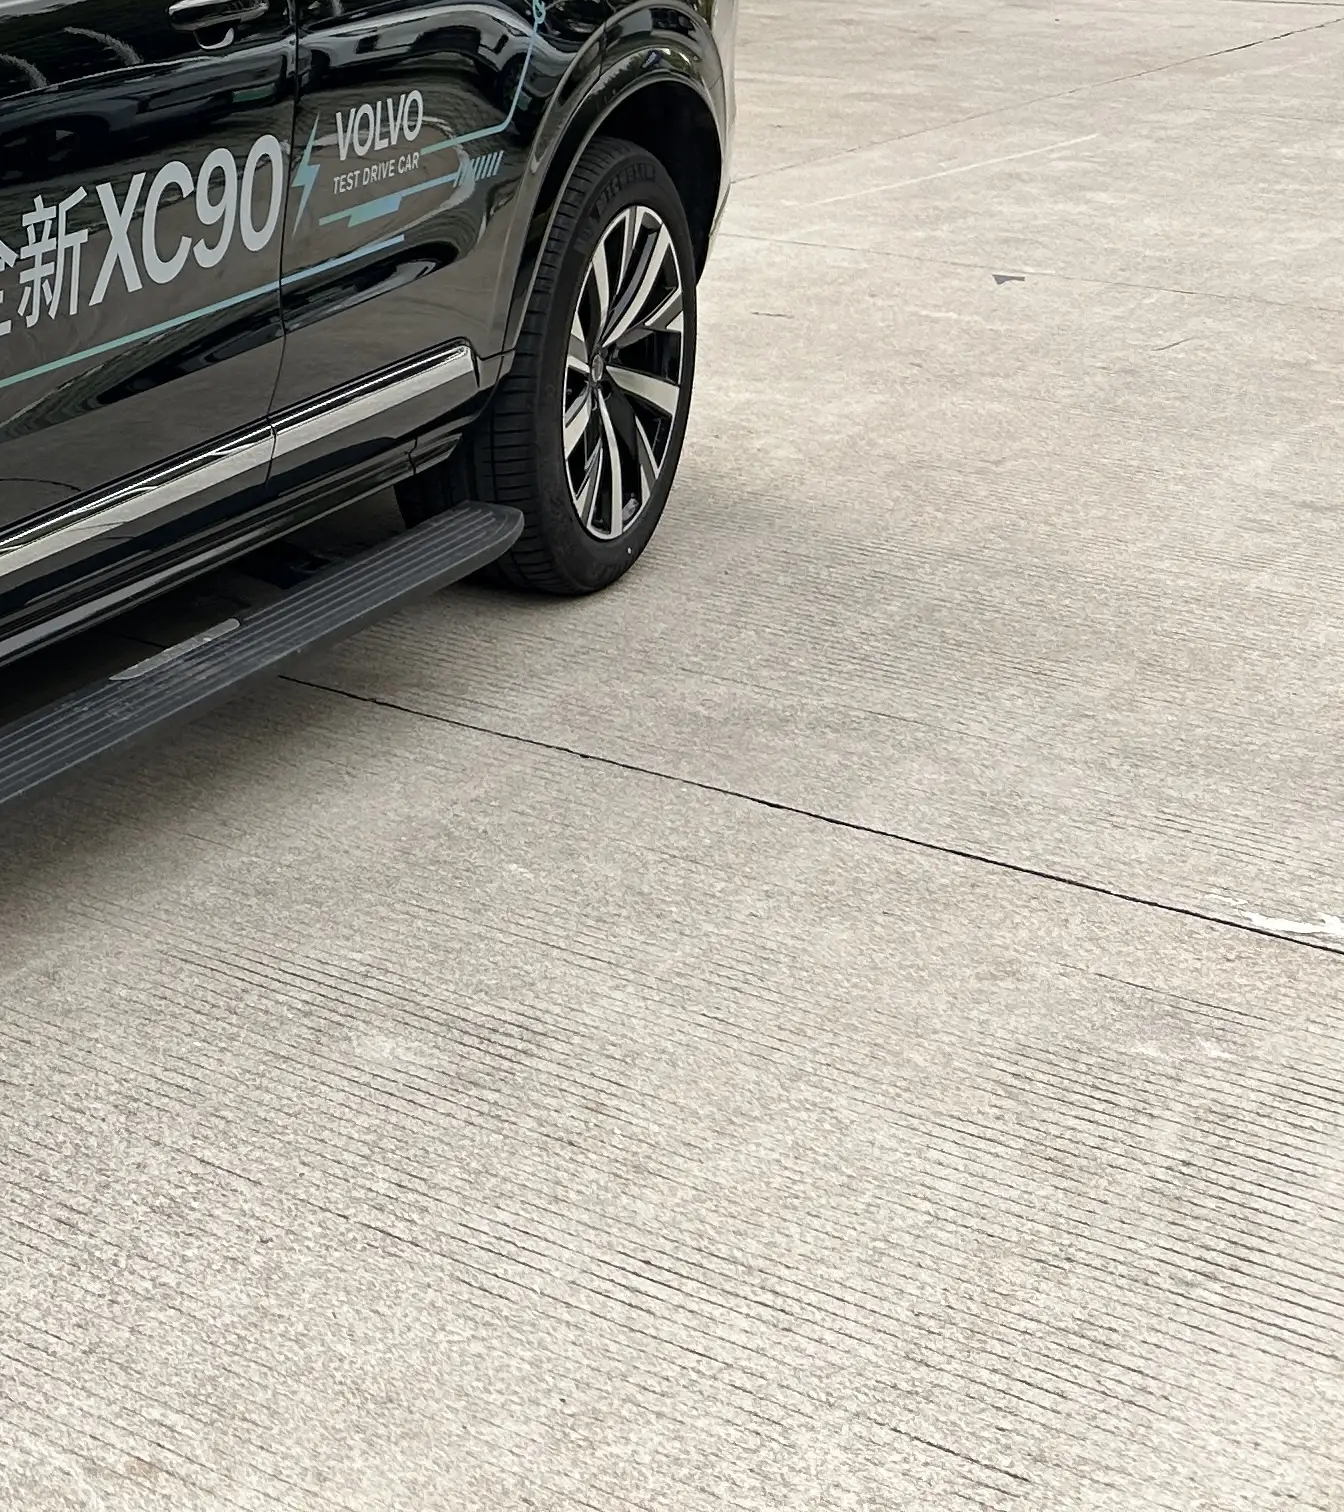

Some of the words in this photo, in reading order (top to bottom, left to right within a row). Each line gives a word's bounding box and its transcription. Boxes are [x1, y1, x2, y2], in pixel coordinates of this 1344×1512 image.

[335, 89, 424, 161] VOLVO
[333, 170, 361, 195] TEST
[362, 159, 396, 185] DRIVE
[397, 151, 421, 174] CAR
